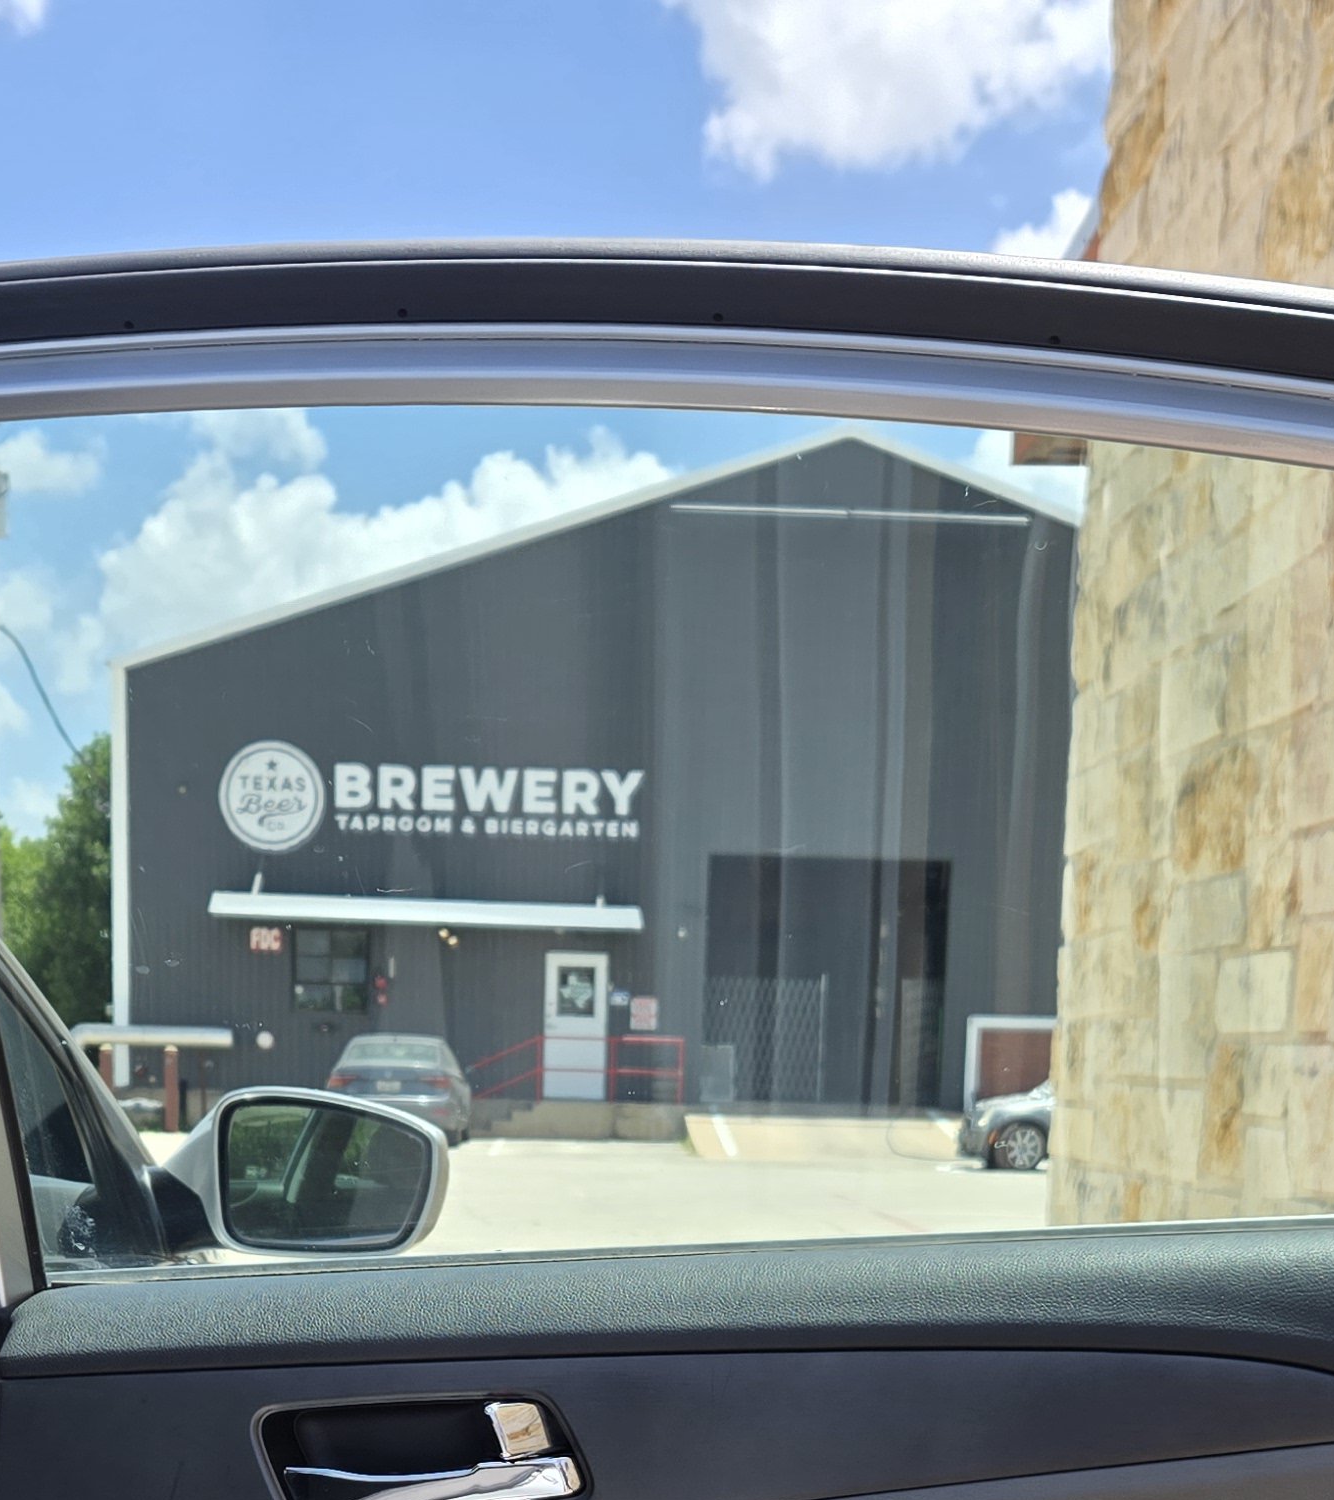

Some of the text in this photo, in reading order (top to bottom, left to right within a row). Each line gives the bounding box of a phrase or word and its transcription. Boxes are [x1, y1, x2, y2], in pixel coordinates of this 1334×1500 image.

[239, 775, 306, 792] TEXAS
[334, 762, 644, 815] BREWERY
[236, 793, 307, 826] Beer
[334, 813, 640, 838] TAPROOM & BIERGARTEN
